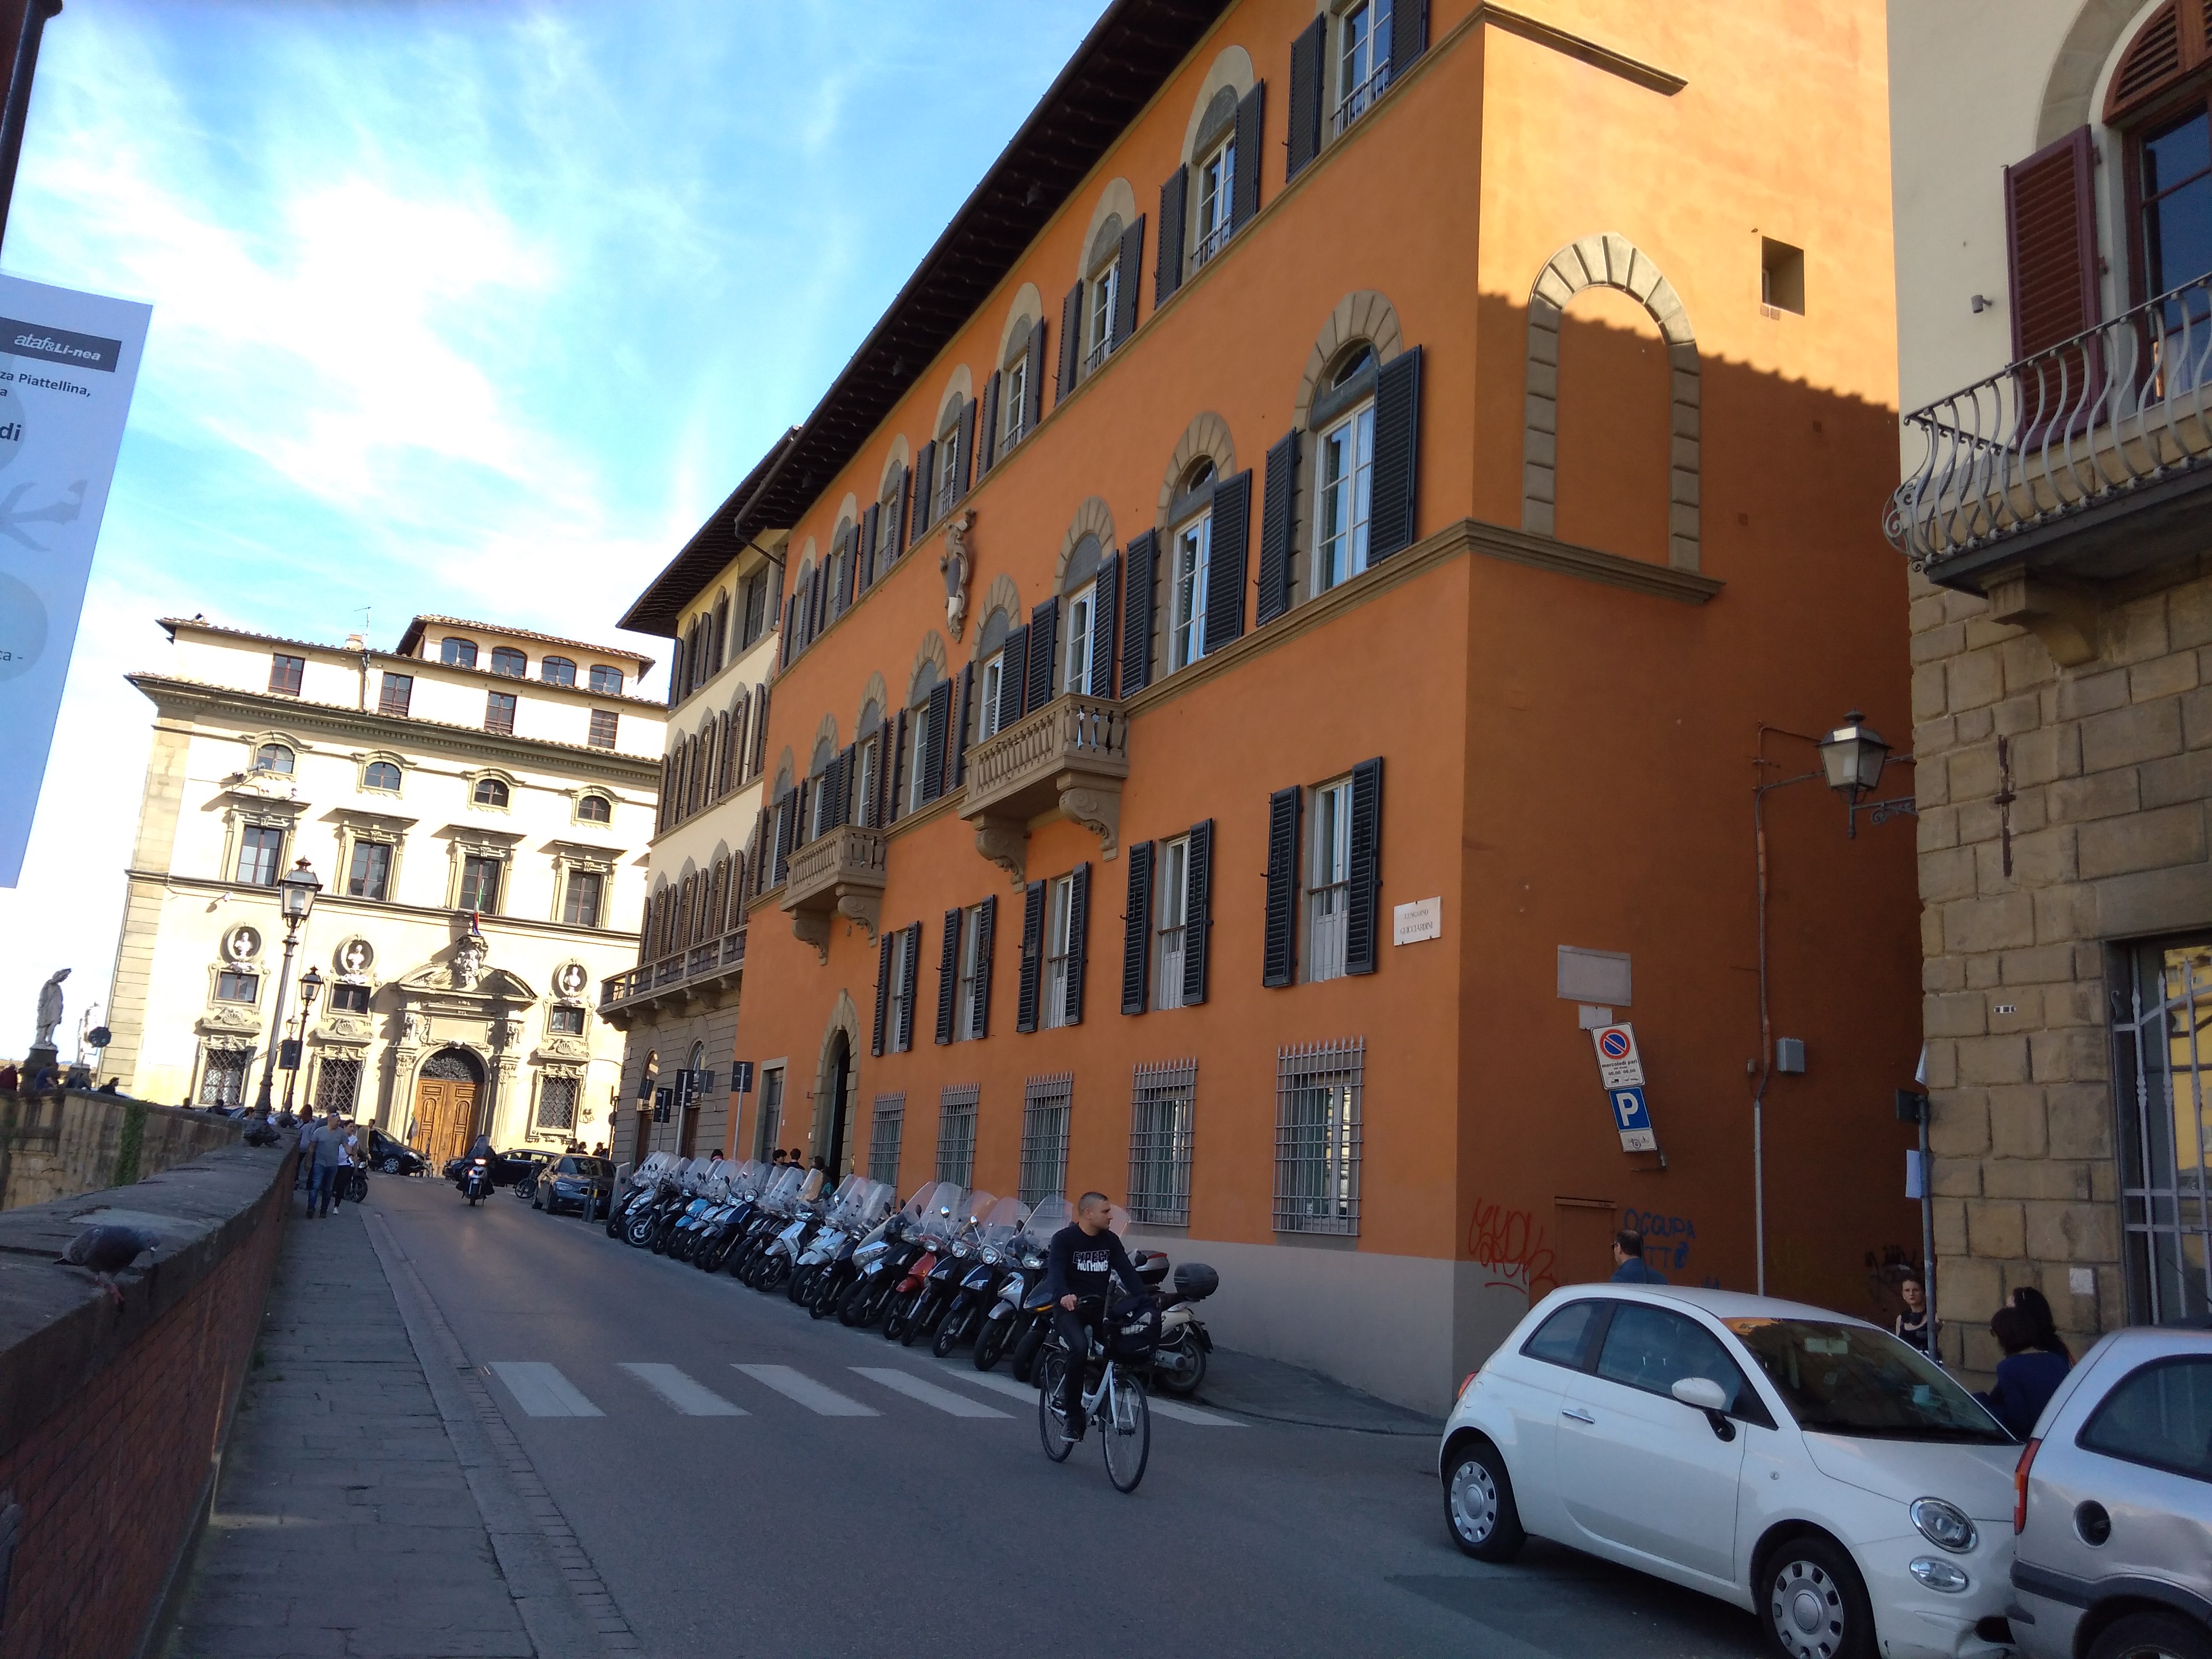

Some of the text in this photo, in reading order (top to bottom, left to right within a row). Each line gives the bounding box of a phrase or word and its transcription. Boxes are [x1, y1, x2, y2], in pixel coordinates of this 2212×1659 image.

[19, 373, 90, 397] Piattellina,
[0, 423, 21, 441] di
[1404, 909, 1429, 919] LUNGARNO
[1400, 921, 1433, 934] GUICCIARDINI
[1616, 1092, 1638, 1126] P
[1077, 1259, 1108, 1271] NOTHING
